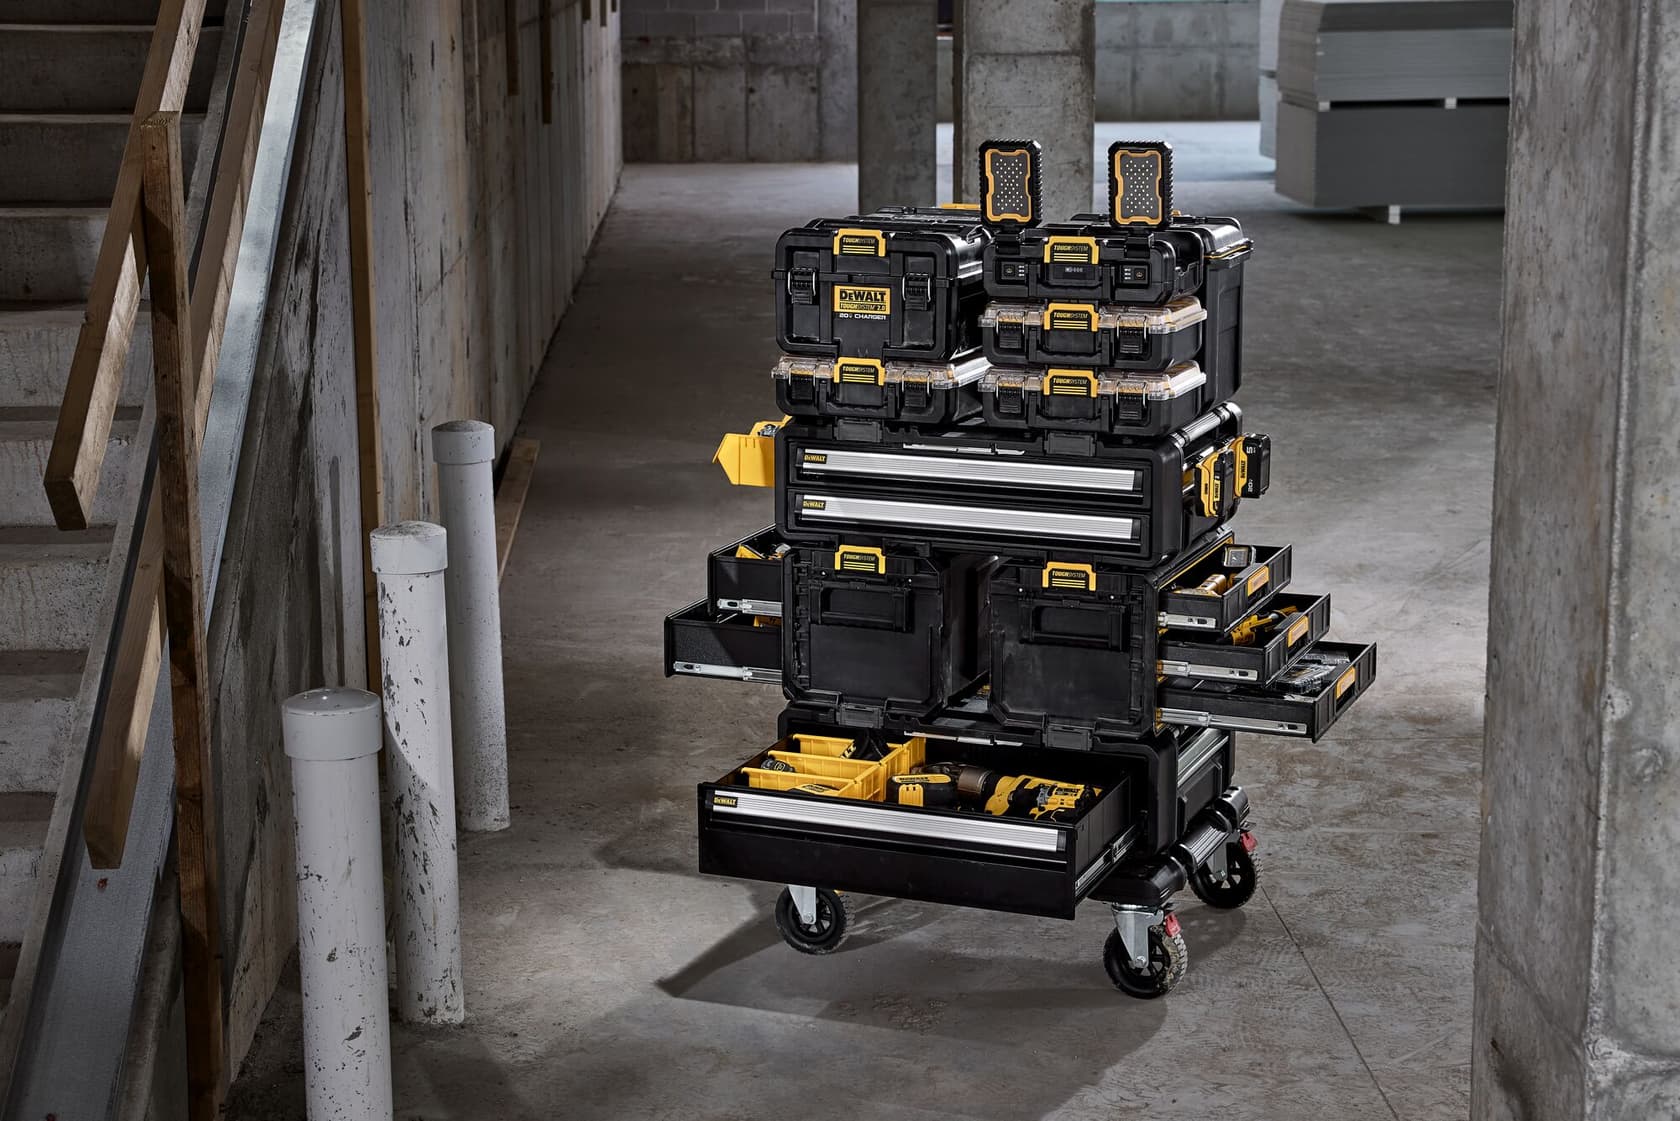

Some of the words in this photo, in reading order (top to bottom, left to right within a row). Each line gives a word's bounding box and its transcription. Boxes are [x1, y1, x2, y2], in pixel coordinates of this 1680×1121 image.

[839, 290, 887, 302] DEWALT
[854, 313, 887, 321] CHARGER
[804, 454, 826, 462] DEWALT
[713, 796, 737, 805] DEWALT
